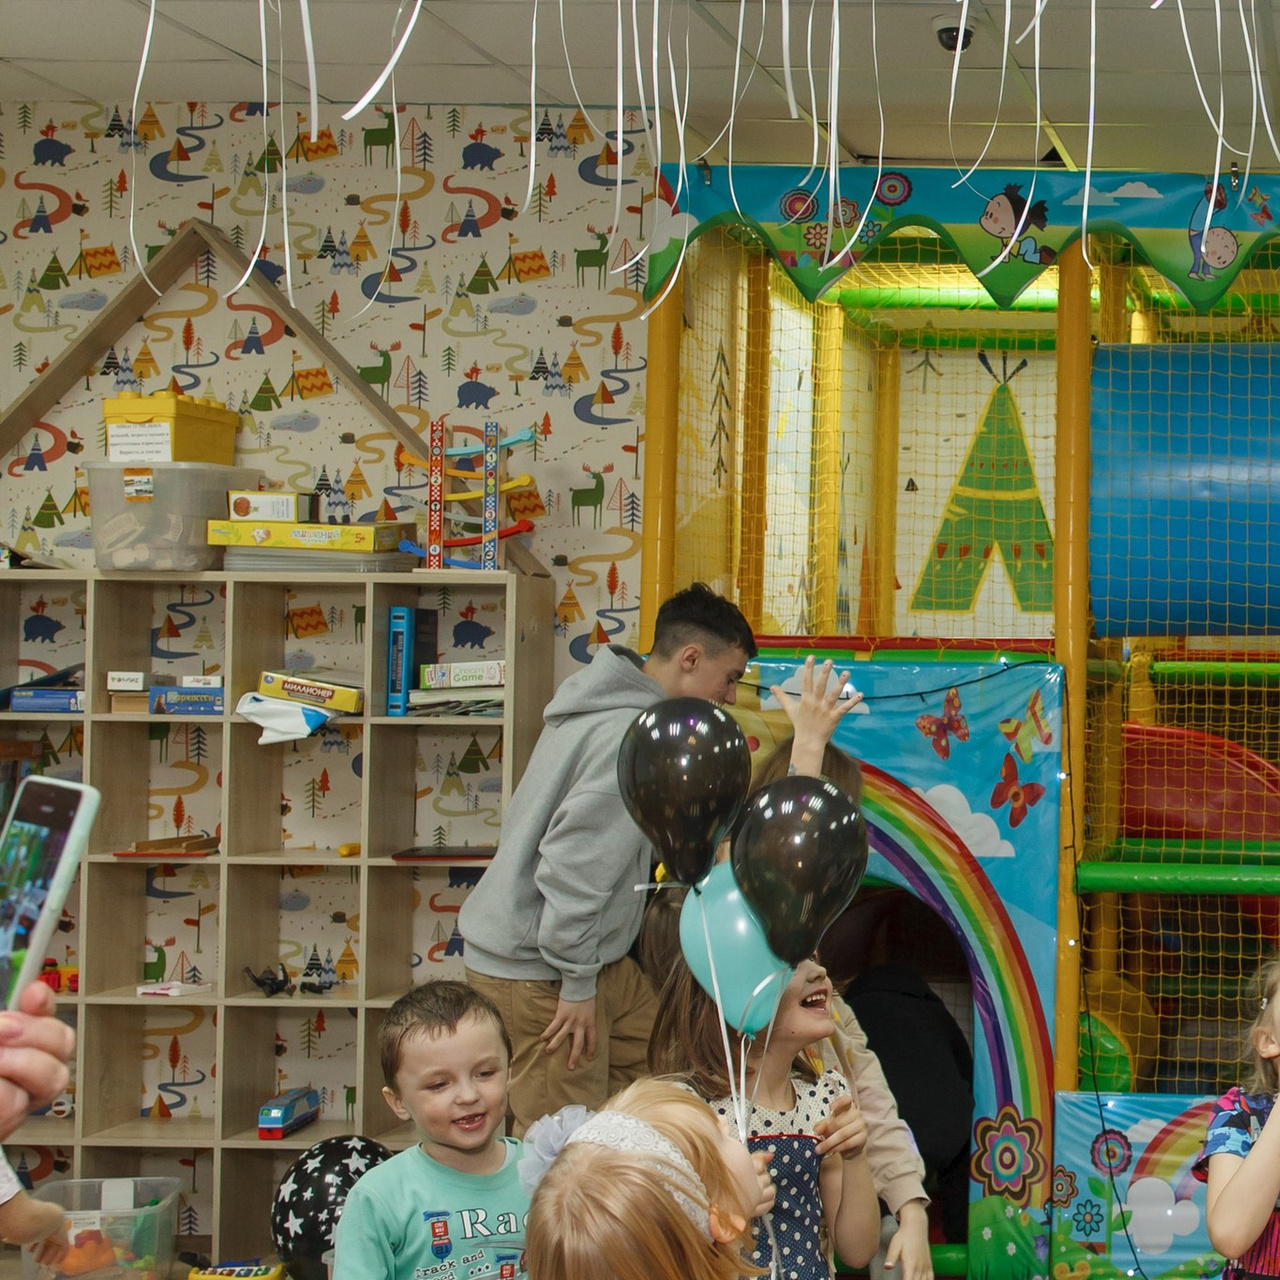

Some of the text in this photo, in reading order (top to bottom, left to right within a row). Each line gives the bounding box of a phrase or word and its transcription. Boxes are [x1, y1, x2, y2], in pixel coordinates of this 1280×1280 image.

[354, 532, 366, 544] 5+
[453, 672, 484, 682] Game
[283, 681, 333, 697] МИЛЛИОНЕР
[416, 1250, 485, 1277] Track and
